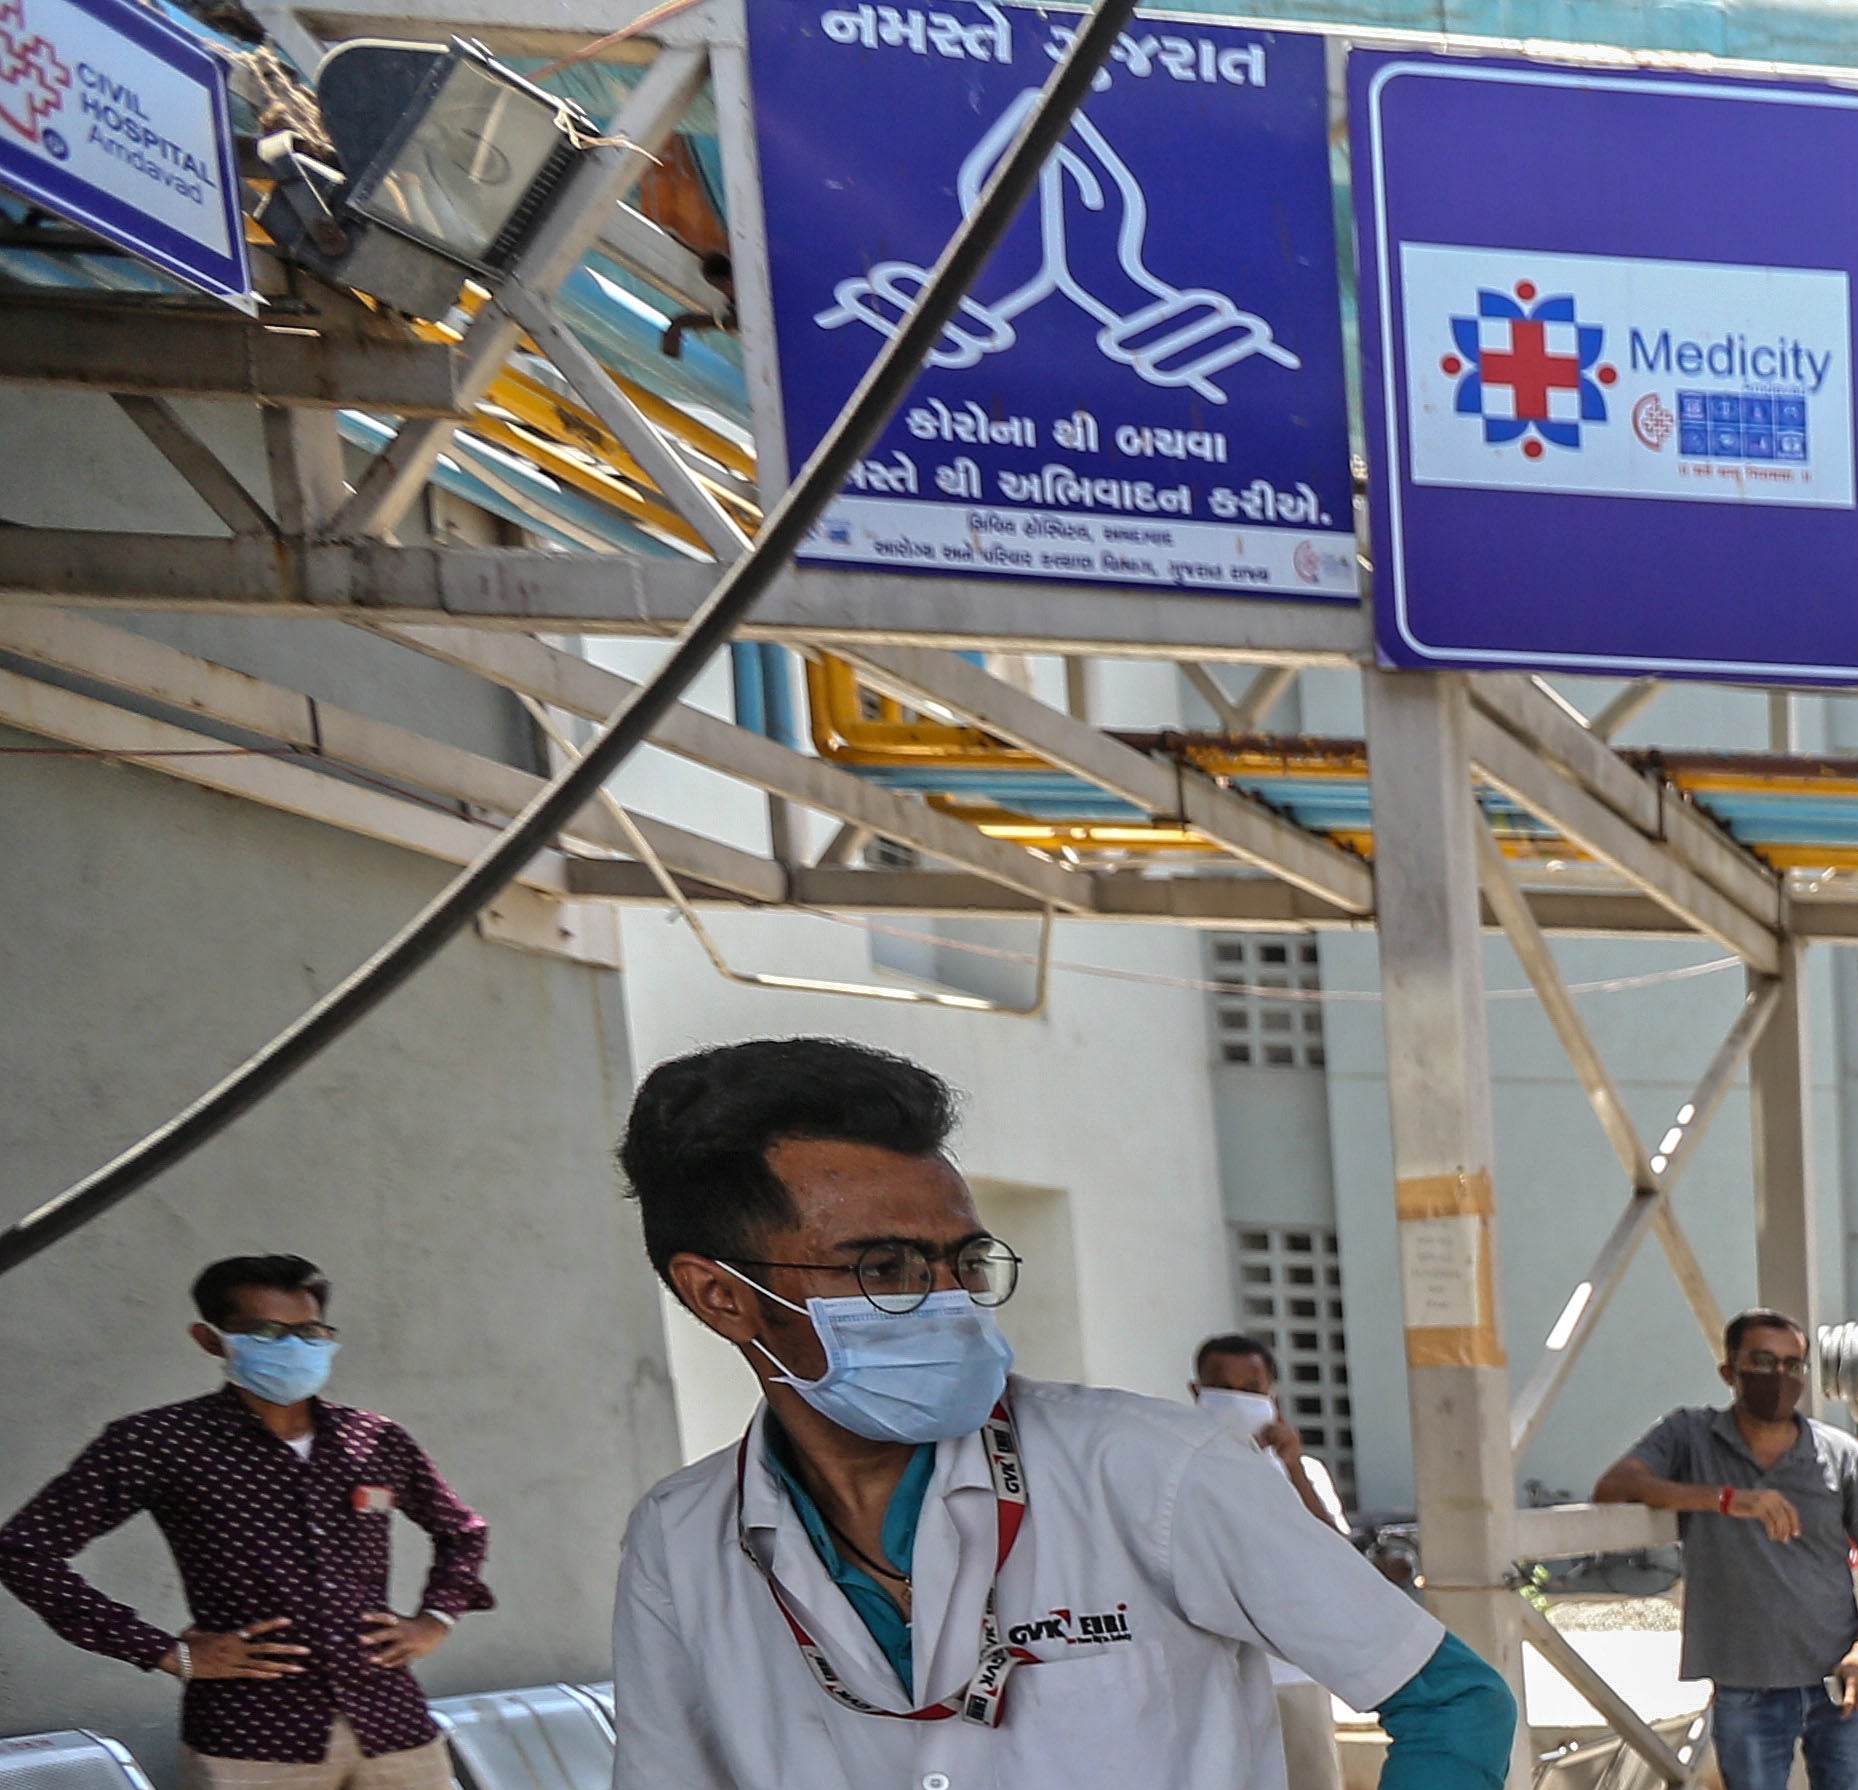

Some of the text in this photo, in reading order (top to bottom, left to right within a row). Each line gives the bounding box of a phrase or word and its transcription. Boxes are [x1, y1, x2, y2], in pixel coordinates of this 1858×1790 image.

[76, 62, 149, 121] CIVIL
[79, 92, 217, 190] HOSPITAL
[1629, 326, 1832, 391] Medicity
[906, 398, 1226, 463] કોરોના થી બચવા
[935, 456, 982, 499] થી
[998, 463, 1191, 515] અભિવાદન
[1207, 482, 1332, 526] કરીએ.
[1008, 1618, 1067, 1645] GVK
